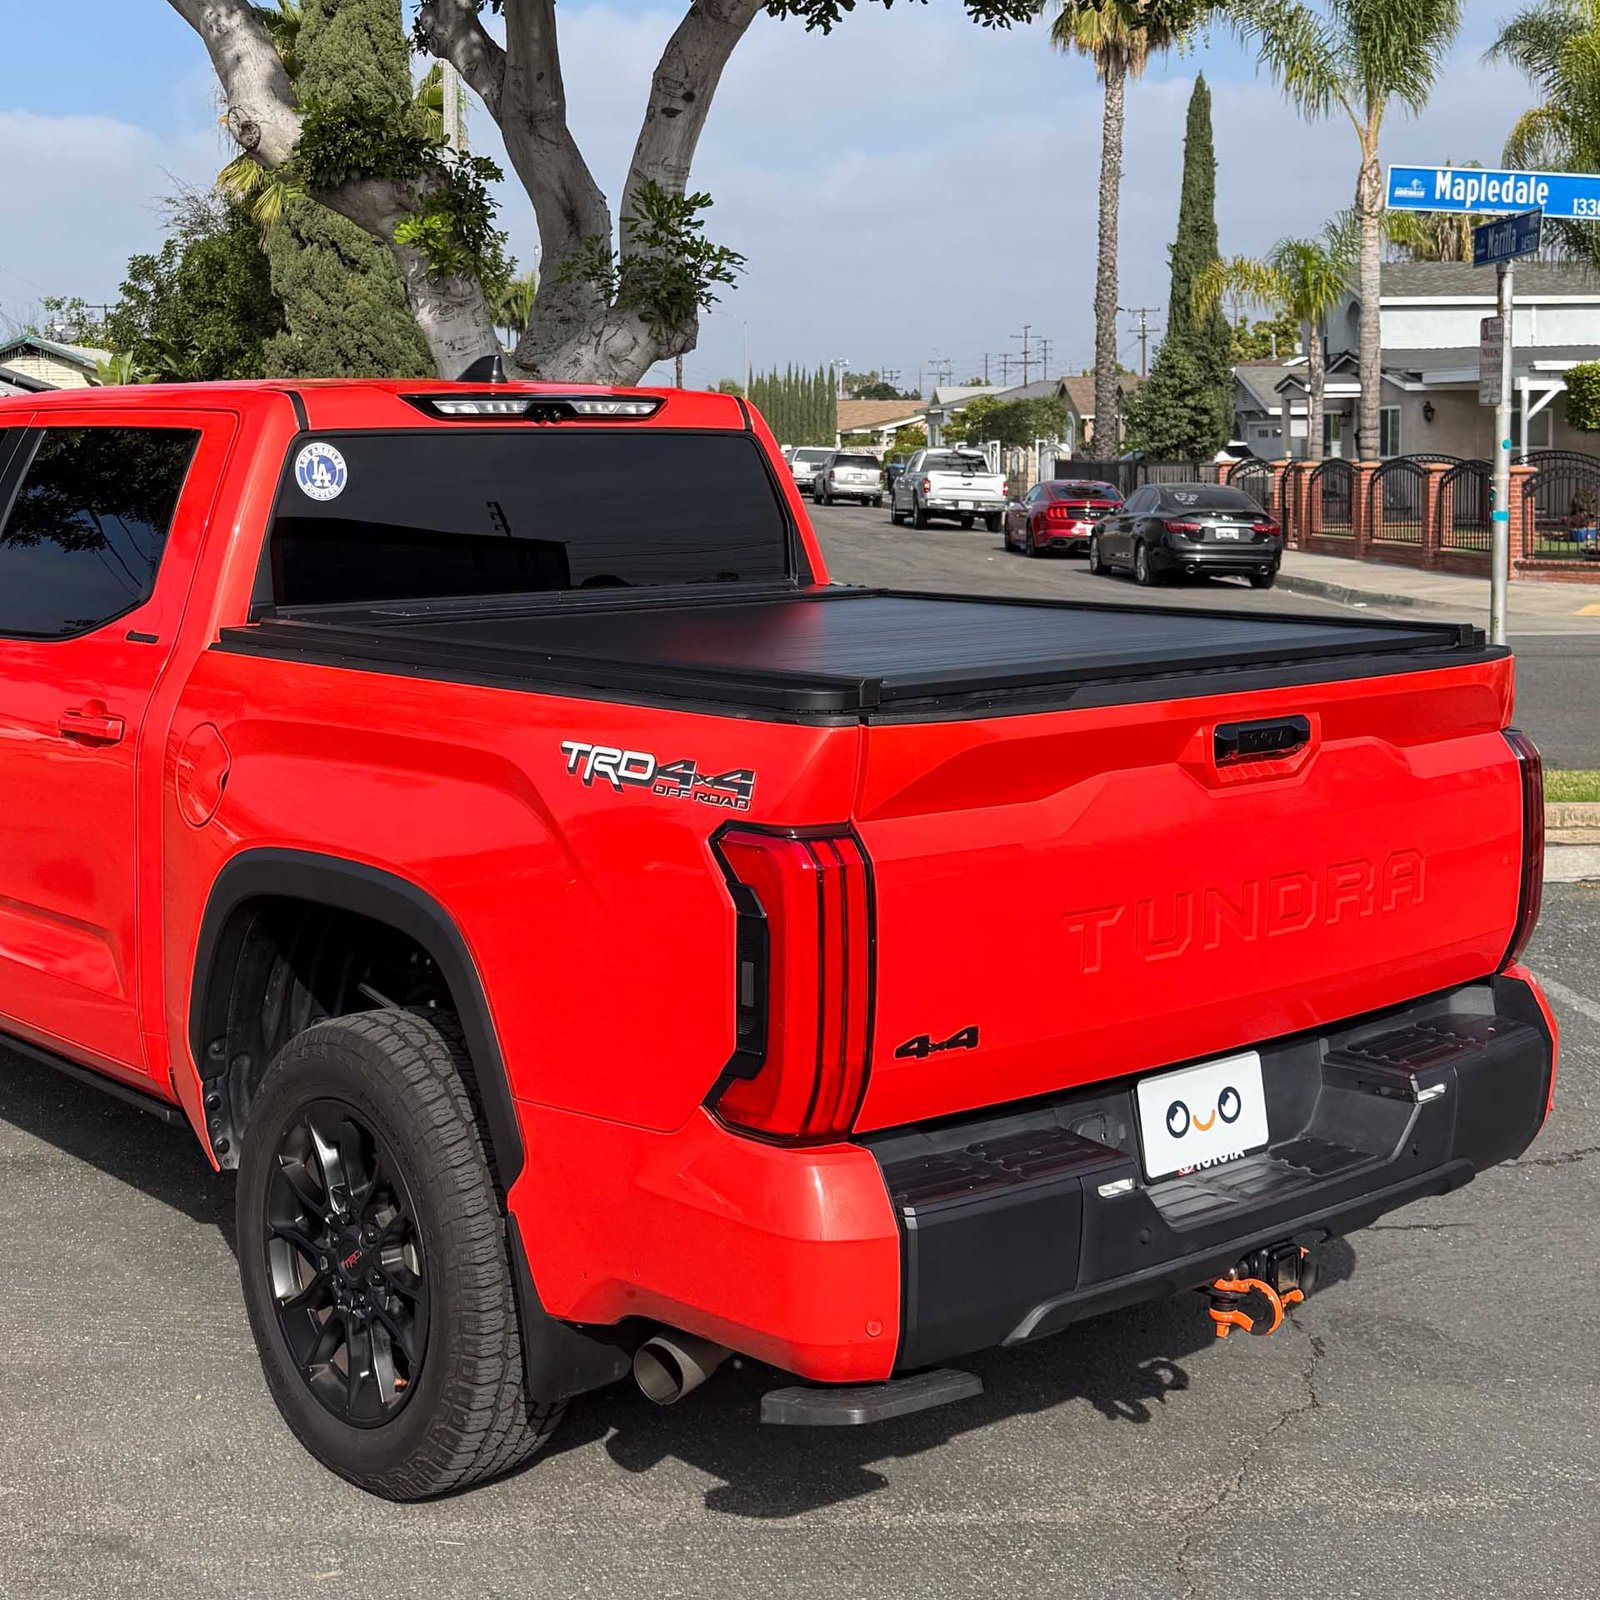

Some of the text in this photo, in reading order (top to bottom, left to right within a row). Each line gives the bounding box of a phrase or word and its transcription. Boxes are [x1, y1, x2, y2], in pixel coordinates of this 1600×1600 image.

[1434, 170, 1549, 209] Mapledale
[1487, 222, 1517, 259] Marilla
[311, 456, 332, 487] LA
[561, 740, 656, 793] TRD
[652, 784, 751, 812] OFF ROAD
[1061, 848, 1427, 975] TUNDRA
[340, 1249, 362, 1269] TRD
